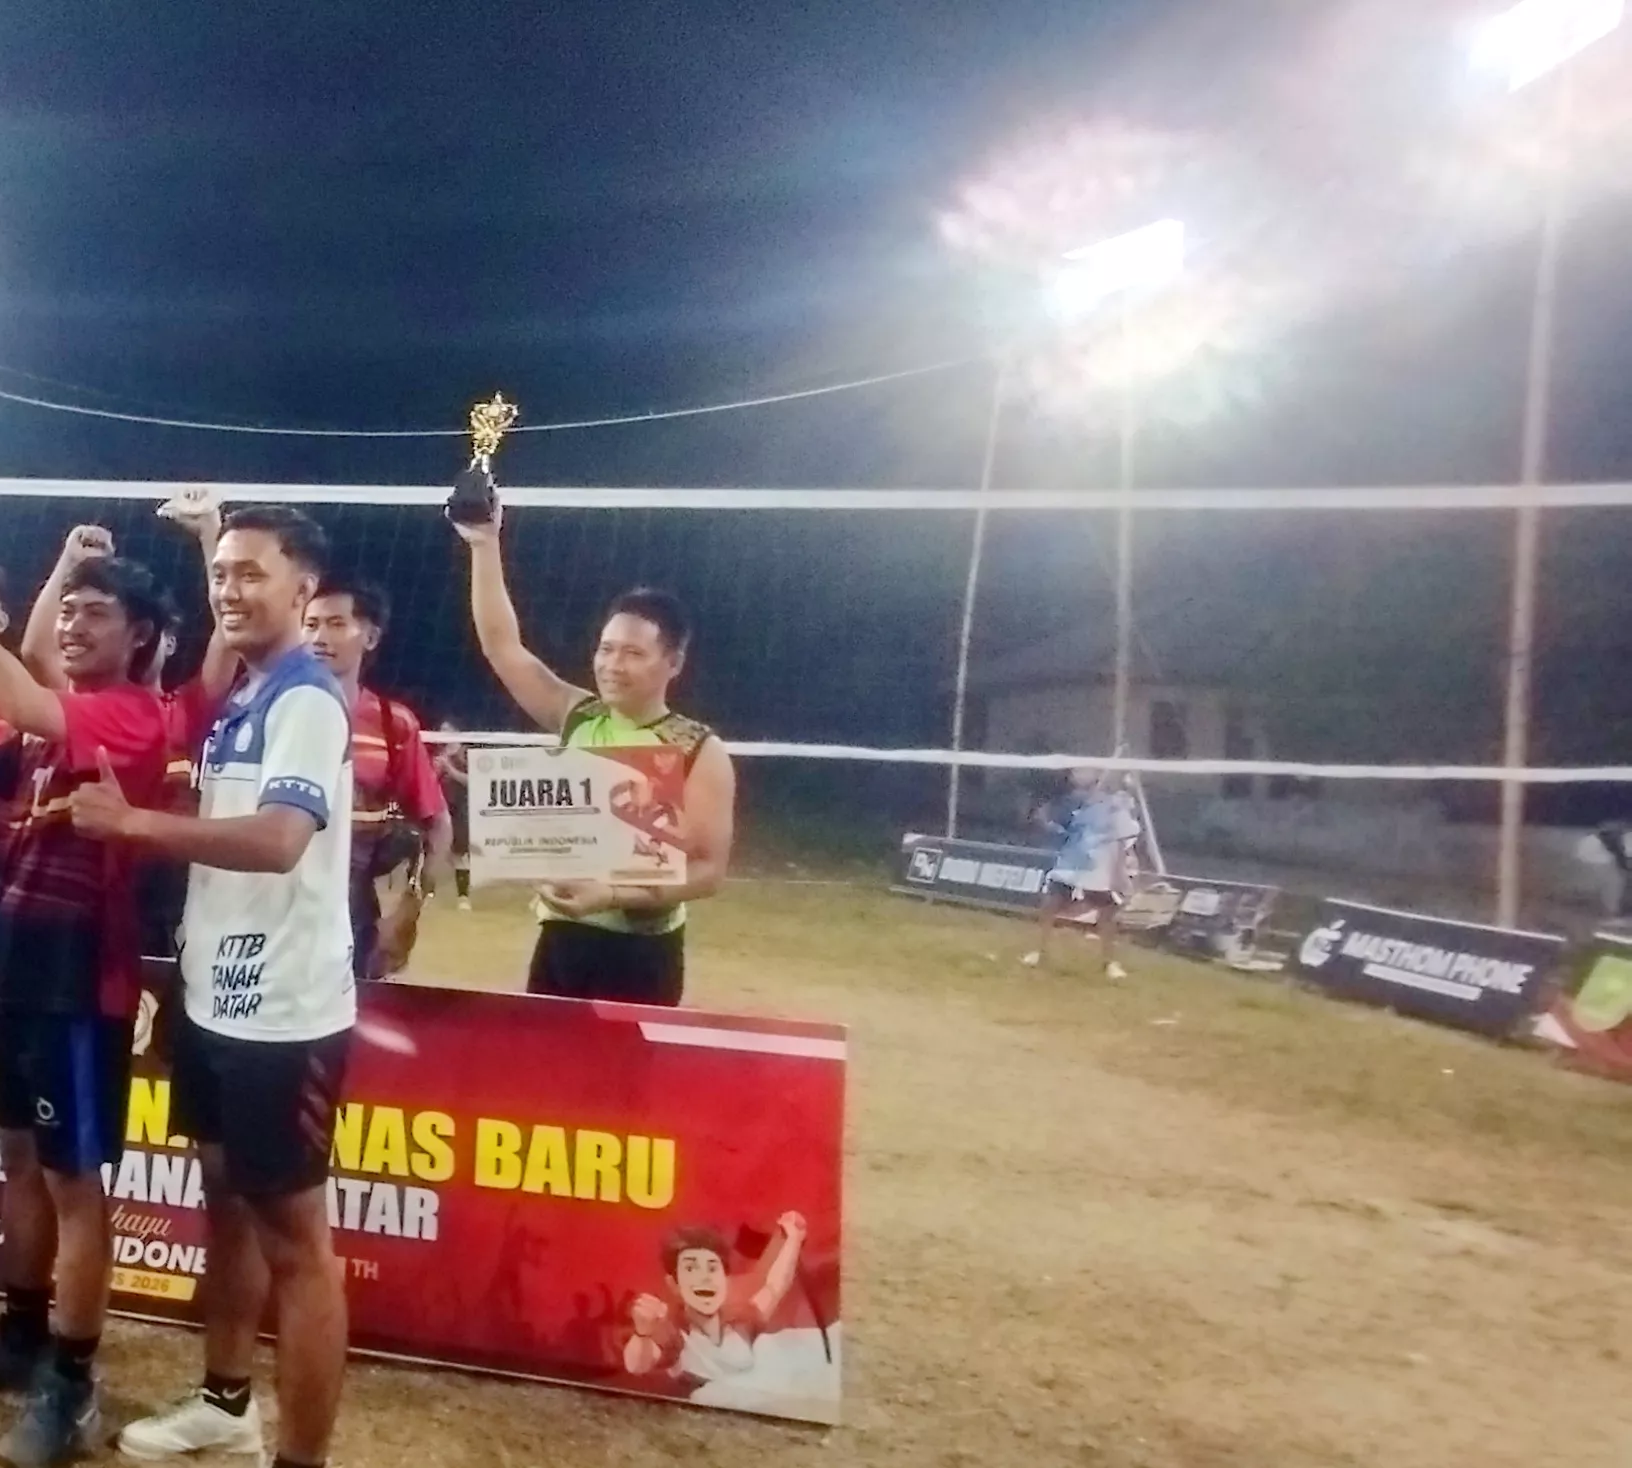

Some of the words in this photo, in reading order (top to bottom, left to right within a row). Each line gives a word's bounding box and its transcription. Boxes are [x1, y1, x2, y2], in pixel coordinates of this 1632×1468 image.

[269, 779, 322, 798] KTTB
[487, 777, 574, 808] JUARA
[579, 777, 593, 806] 1
[216, 932, 267, 961] KTTB
[211, 962, 267, 991] TANAH
[1342, 931, 1454, 978] MASTHOM
[1448, 951, 1536, 995] PHONE
[212, 992, 264, 1020] DATAR
[328, 1101, 455, 1183] NAS
[474, 1117, 676, 1210] BARU
[100, 1149, 207, 1210] ANA
[110, 1203, 173, 1241] hayu
[351, 1258, 379, 1281] TH
